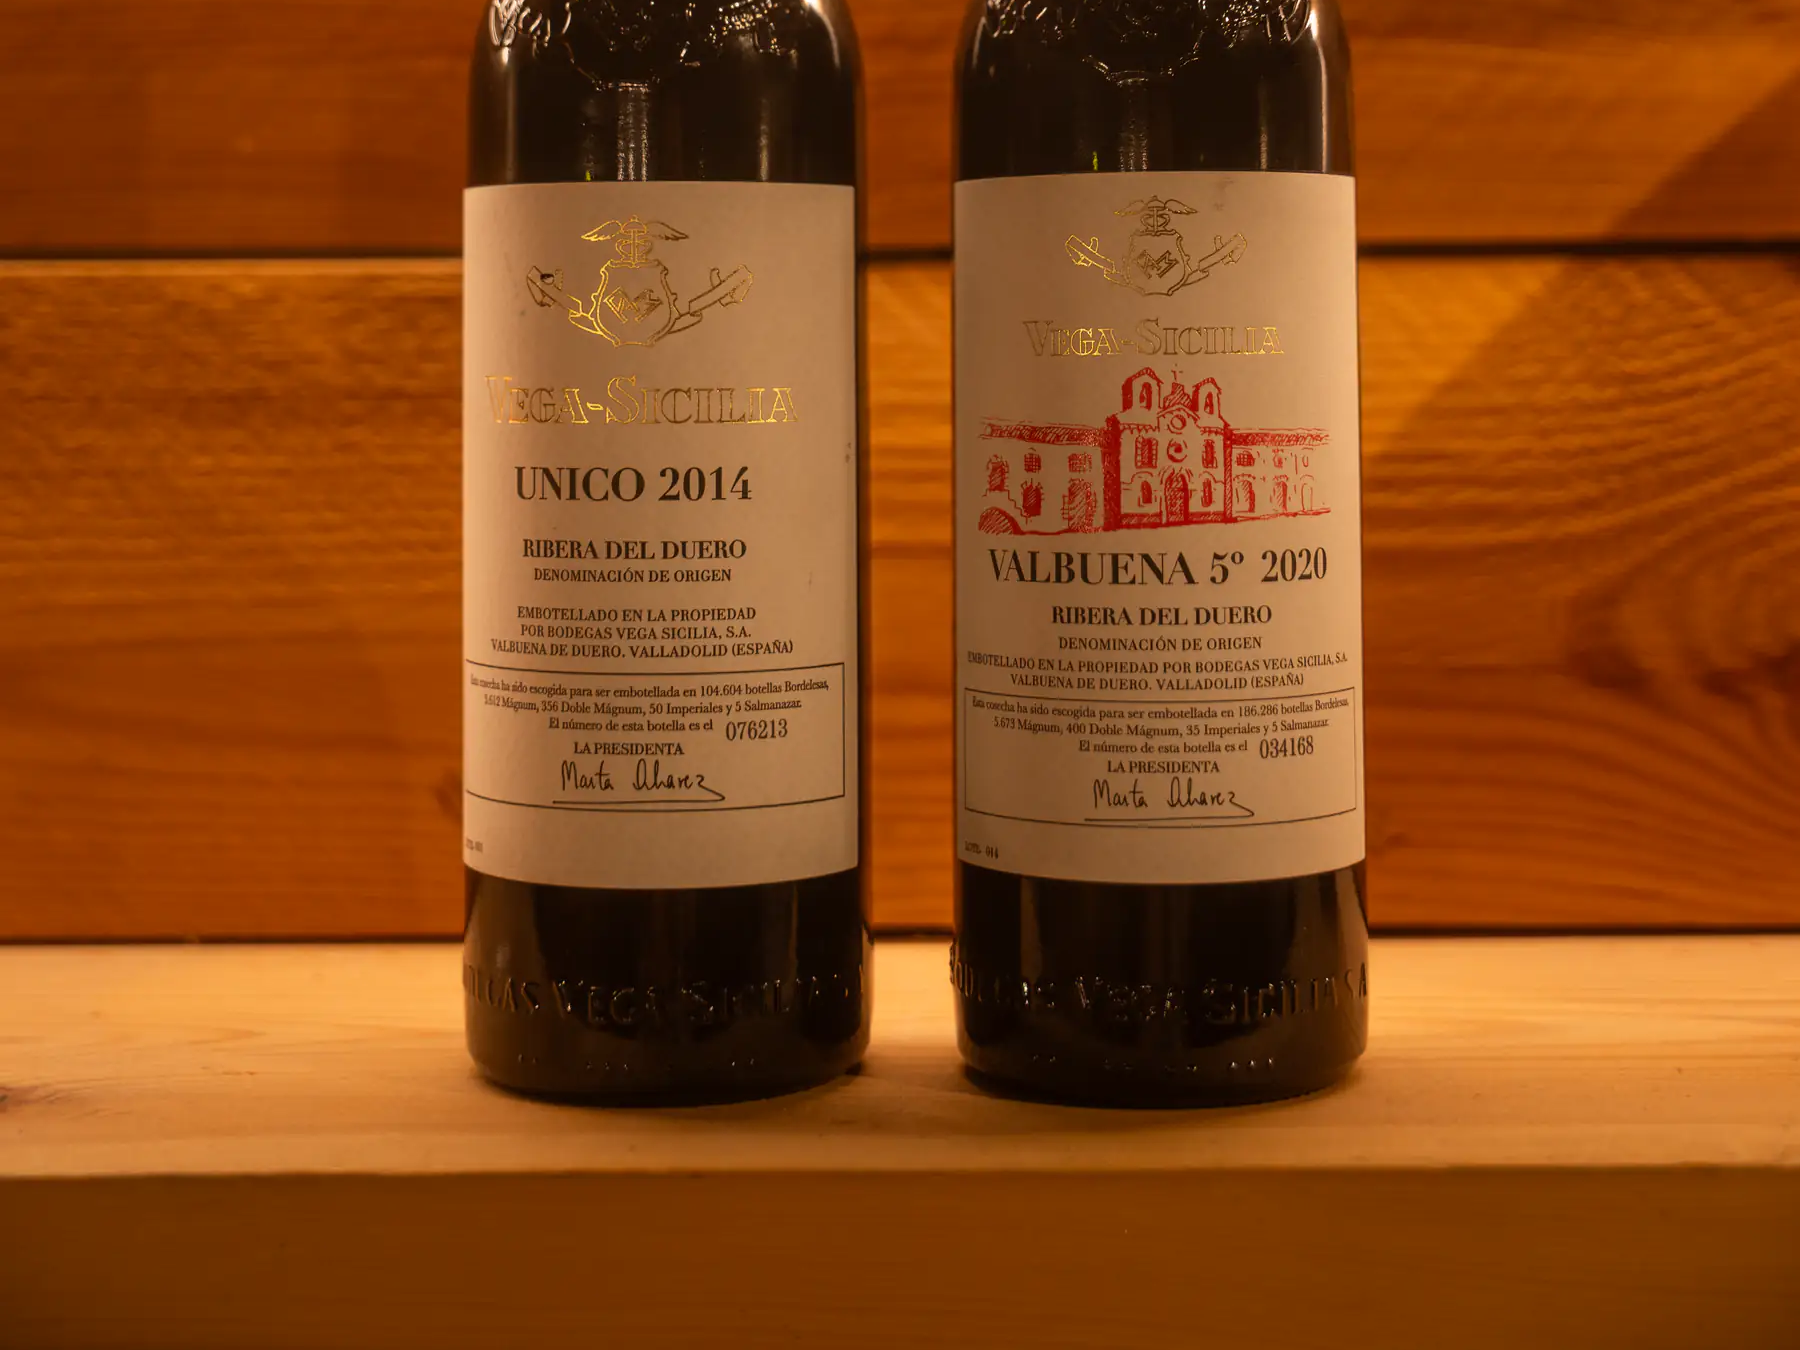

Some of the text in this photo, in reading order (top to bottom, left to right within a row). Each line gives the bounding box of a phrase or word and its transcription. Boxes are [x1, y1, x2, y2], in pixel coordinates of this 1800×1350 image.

[1023, 318, 1284, 356] VEGA-SICILIA
[485, 375, 798, 424] VEGA-SICILIA
[514, 466, 752, 502] UNICO 2014
[523, 539, 746, 559] RIBERA DEL DUERO
[534, 567, 731, 582] DENOMINACIÓN DE ORIGEN
[988, 549, 1199, 585] VALBUENA
[1261, 547, 1327, 583] 2020
[517, 606, 756, 622] EMBOTELLADO EN LA PROPIEDAD
[1052, 605, 1272, 626] RIBERA DEL DUERO
[521, 624, 751, 640] POR BODEGAS VEGA SICILIA, S.A.
[491, 639, 793, 658] VALBUENA DE DUERO. VALLADOLID (ESPAÑA)
[1058, 635, 1262, 651] DENOMINACIÓN DE ORIGEN
[967, 651, 1035, 670] EMBOTELLADO
[1038, 659, 1054, 670] EN
[1058, 659, 1075, 672] LA
[1078, 660, 1158, 674] PROPIEDAD
[1163, 662, 1191, 674] POR
[1196, 660, 1259, 673] BODEGAS
[1263, 658, 1294, 670] VEGA
[1297, 654, 1334, 668] SICILIA,
[512, 681, 527, 693] sido
[529, 684, 567, 698] escogida
[569, 688, 593, 700] para
[595, 689, 611, 697] ser
[613, 686, 680, 698] embotellada
[683, 689, 696, 697] en
[701, 684, 743, 697] 104.604
[745, 682, 782, 694] botellas
[1010, 672, 1303, 690] VALBUENA DE DUERO. VALLADOLID (ESPAÑA)
[502, 697, 539, 713] Mágnum,
[541, 700, 558, 712] 356
[561, 701, 590, 713] Doble
[594, 702, 646, 717] Mágnum,
[649, 703, 663, 714] 50
[666, 702, 723, 718] Imperiales
[726, 704, 732, 716] y
[735, 701, 741, 712] 5
[986, 701, 1015, 712] cosecha
[1017, 702, 1028, 713] ha
[1030, 703, 1049, 715] sido
[1052, 706, 1096, 720] escogida
[1099, 710, 1125, 721] para
[1148, 707, 1217, 719] embotellada
[1221, 710, 1234, 718] en
[1239, 704, 1278, 717] 186.286
[1281, 702, 1313, 714] botellas
[549, 717, 788, 741] El número de esta botella es el 076213
[1017, 718, 1063, 736] Mágnum,
[1066, 723, 1086, 734] 400
[1089, 723, 1123, 735] Doble
[1126, 724, 1183, 739] Mágnum,
[1186, 725, 1200, 736] 35
[1204, 723, 1260, 738] Imperiales
[1263, 725, 1269, 736] y
[1272, 721, 1278, 732] 5
[574, 741, 685, 756] LA PRESIDENTA
[1079, 735, 1313, 759] El número de esta botella es el 034168
[1107, 760, 1220, 774] LA PRESIDENTA
